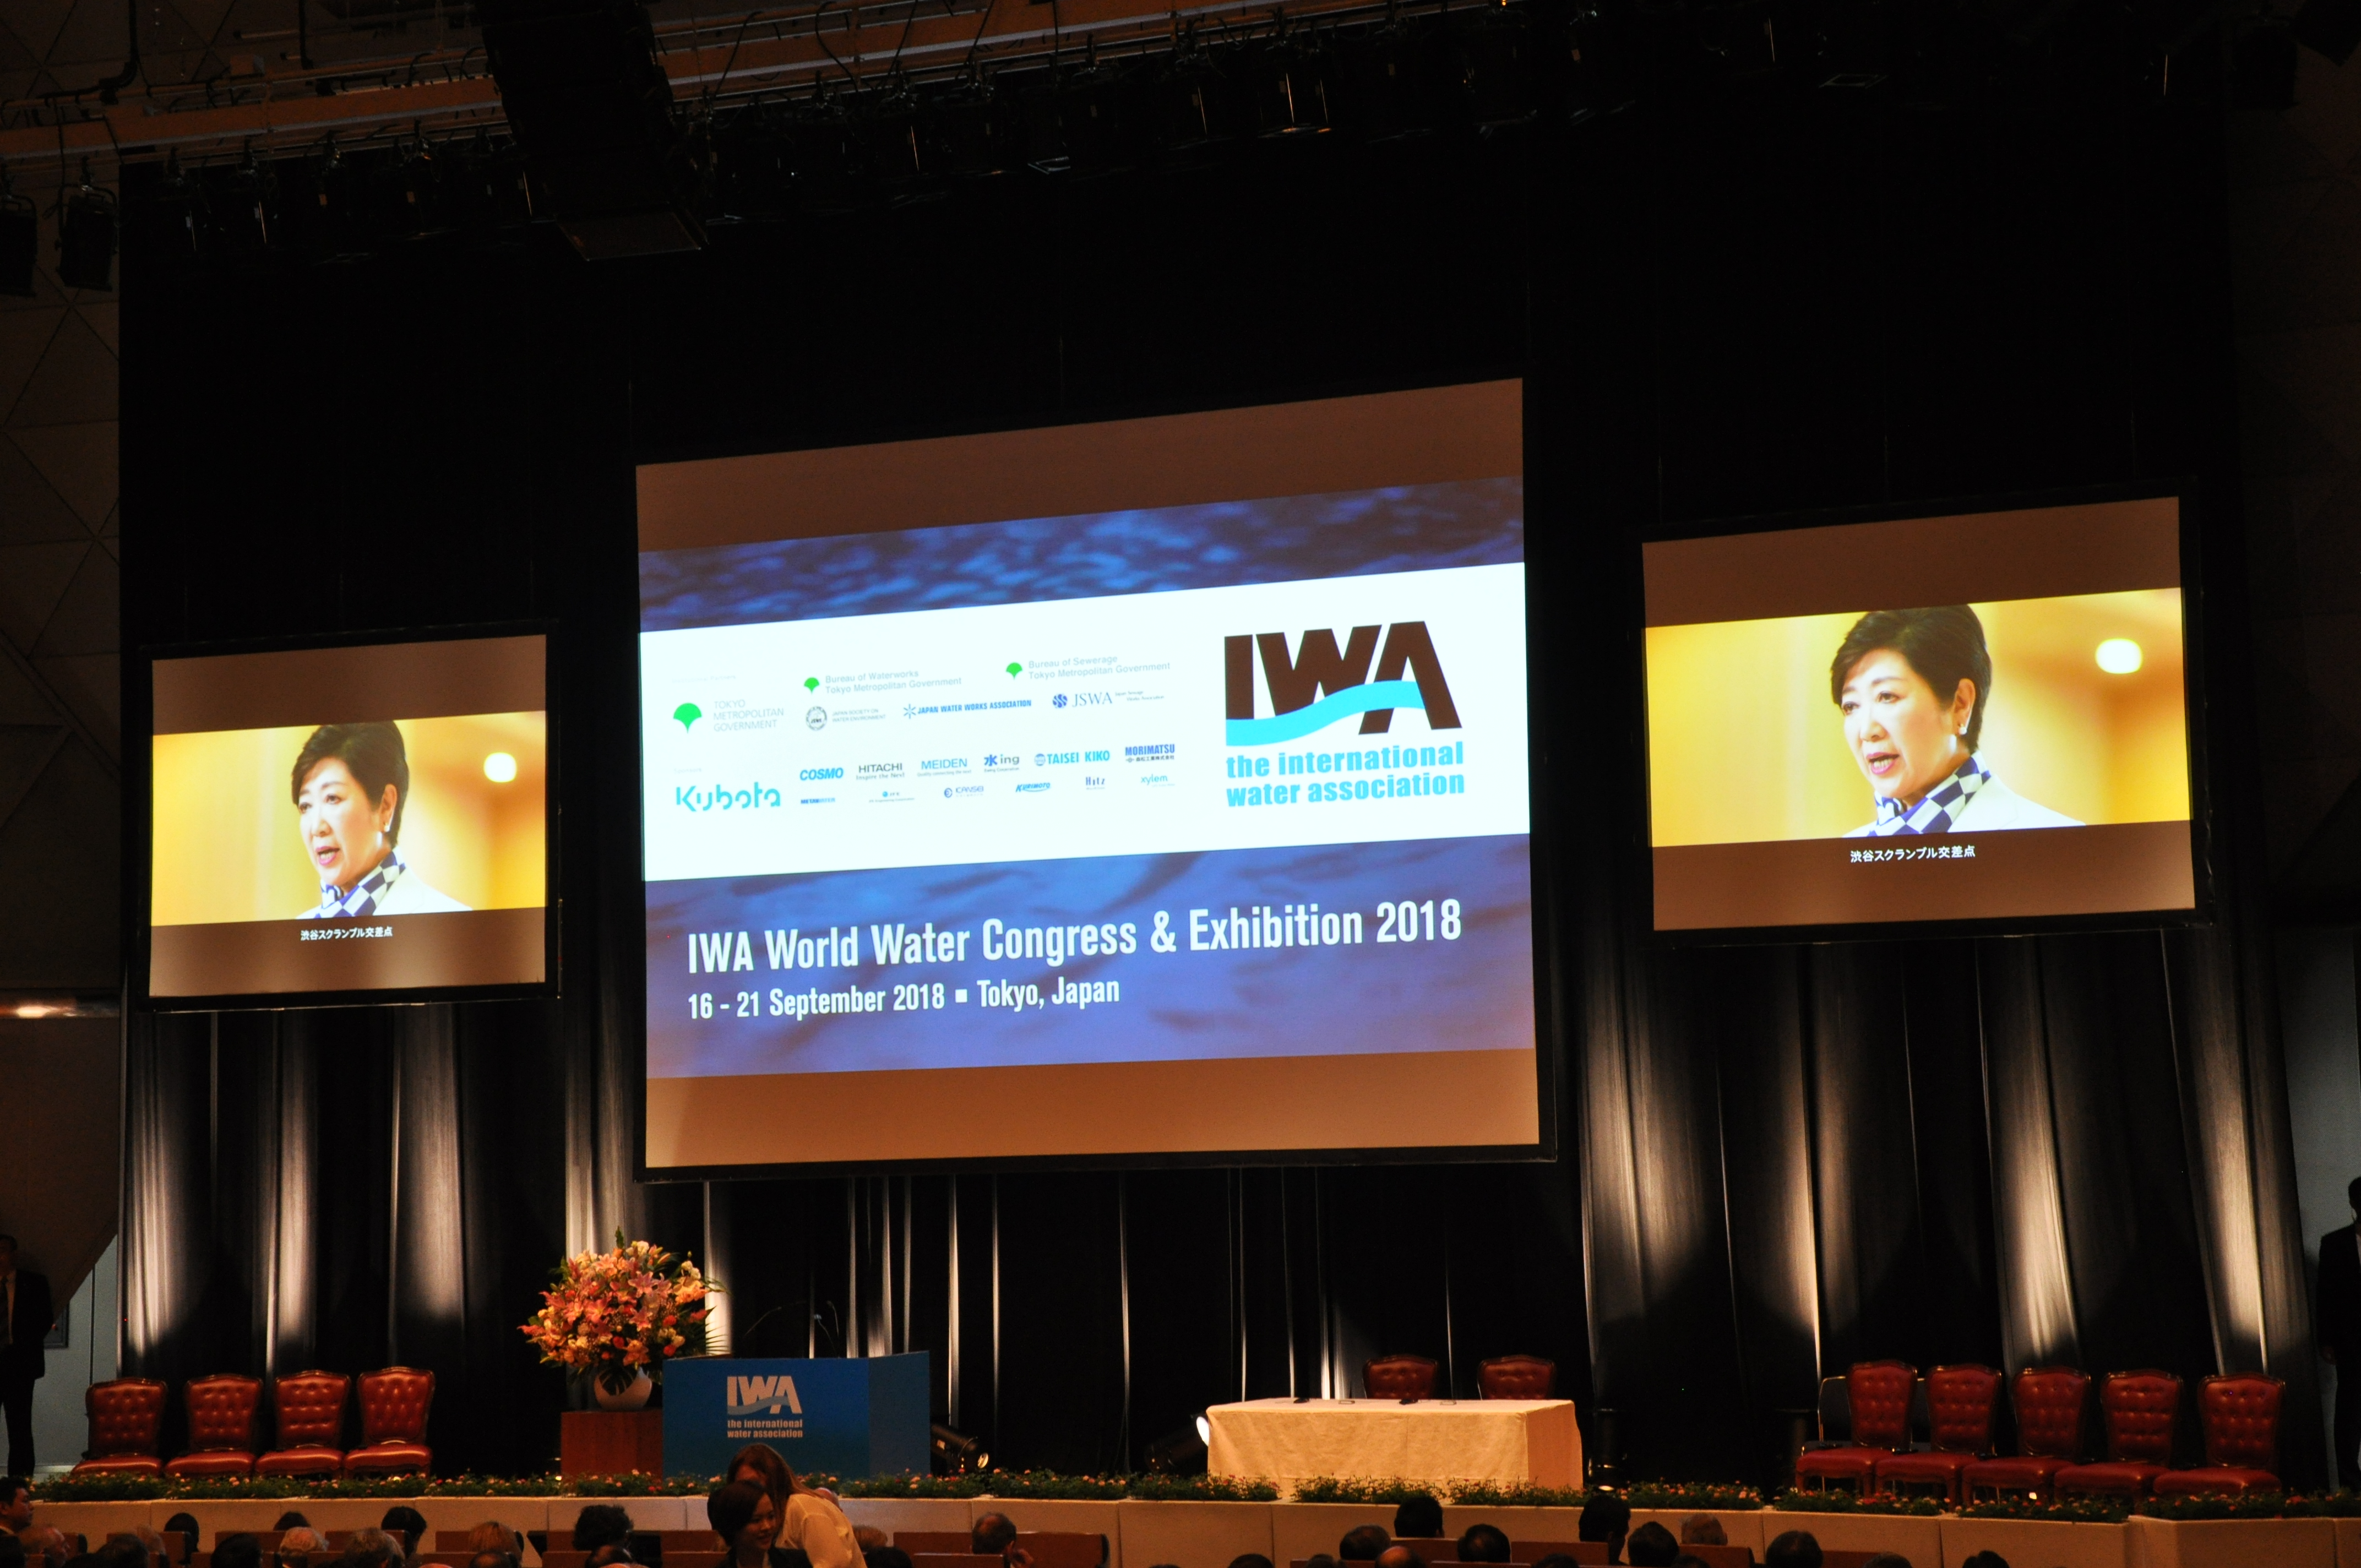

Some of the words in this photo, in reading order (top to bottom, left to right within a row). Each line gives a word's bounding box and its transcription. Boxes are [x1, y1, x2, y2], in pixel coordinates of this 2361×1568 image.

[1029, 661, 1059, 669] Bureau
[1073, 656, 1117, 666] Sewerage
[825, 676, 855, 684] Bureau
[869, 671, 918, 680] Waterworks
[1029, 671, 1055, 680] Tokyo
[1058, 667, 1113, 677] Metropolitan
[1116, 662, 1170, 673] Government
[1225, 620, 1462, 736] IWA
[825, 686, 851, 695] Tokyo
[854, 682, 906, 692] Metropolitan
[909, 677, 961, 688] Government
[715, 699, 746, 709] TOKYO
[989, 700, 1031, 709] ASSOCIATION
[1073, 692, 1112, 707] JSWA
[714, 708, 784, 720] METROPOLITAN
[714, 719, 777, 732] GOVERNMENT
[1125, 744, 1175, 756] MORIMATSU
[1047, 752, 1079, 764] TAISEI
[1085, 750, 1110, 762] KIKO
[1226, 755, 1270, 778] the
[1279, 741, 1464, 776] international
[859, 763, 902, 773] HITACHI
[921, 758, 967, 770] MEIDEN
[800, 767, 844, 781] COSMO
[1140, 774, 1168, 786] xylem
[1015, 782, 1051, 792] KURIMOTO
[1086, 776, 1105, 786] Hitz
[1226, 783, 1301, 807] water
[1308, 772, 1465, 803] association
[675, 782, 781, 812] Kubota
[1850, 845, 1976, 863] 渋谷スクランブル交差点
[300, 926, 393, 941] 渋谷スクランブル交差点
[688, 931, 754, 974] IWA
[764, 925, 858, 970] World
[870, 922, 970, 965] Water
[982, 918, 1137, 967] Congress
[1150, 910, 1177, 954] &
[1189, 903, 1363, 951] Exhibition
[1376, 898, 1462, 944] 2018
[688, 993, 713, 1020] 16
[736, 992, 760, 1018] 21
[769, 985, 886, 1021] September
[893, 982, 945, 1011] 2018
[976, 979, 1045, 1013] Tokyo,
[1051, 977, 1120, 1009] Japan
[727, 1375, 803, 1414] IWA
[727, 1419, 742, 1428] the
[744, 1419, 803, 1428] international
[727, 1430, 751, 1438] water
[753, 1429, 803, 1438] association
